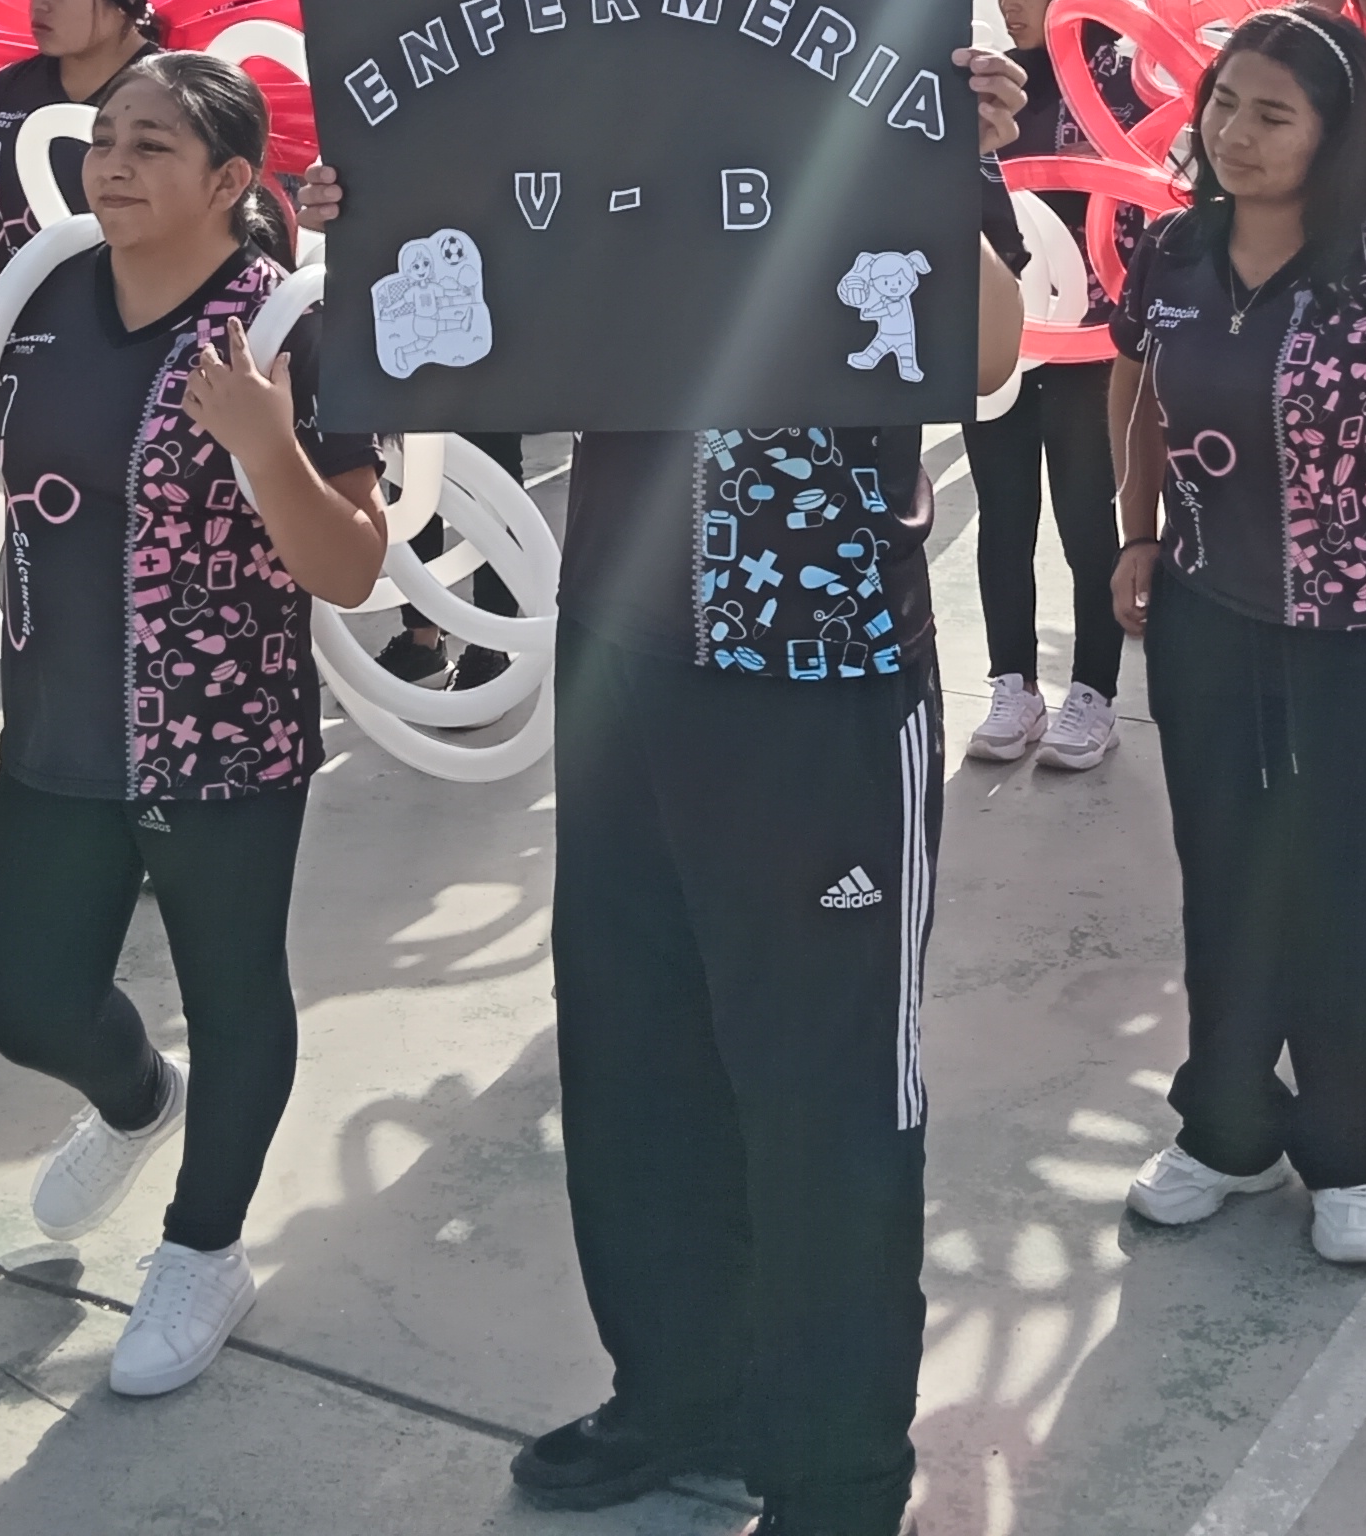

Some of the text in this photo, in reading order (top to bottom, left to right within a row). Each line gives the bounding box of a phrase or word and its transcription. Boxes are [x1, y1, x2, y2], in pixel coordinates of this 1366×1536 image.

[513, 167, 772, 231] V - B
[820, 889, 883, 909] adidas
